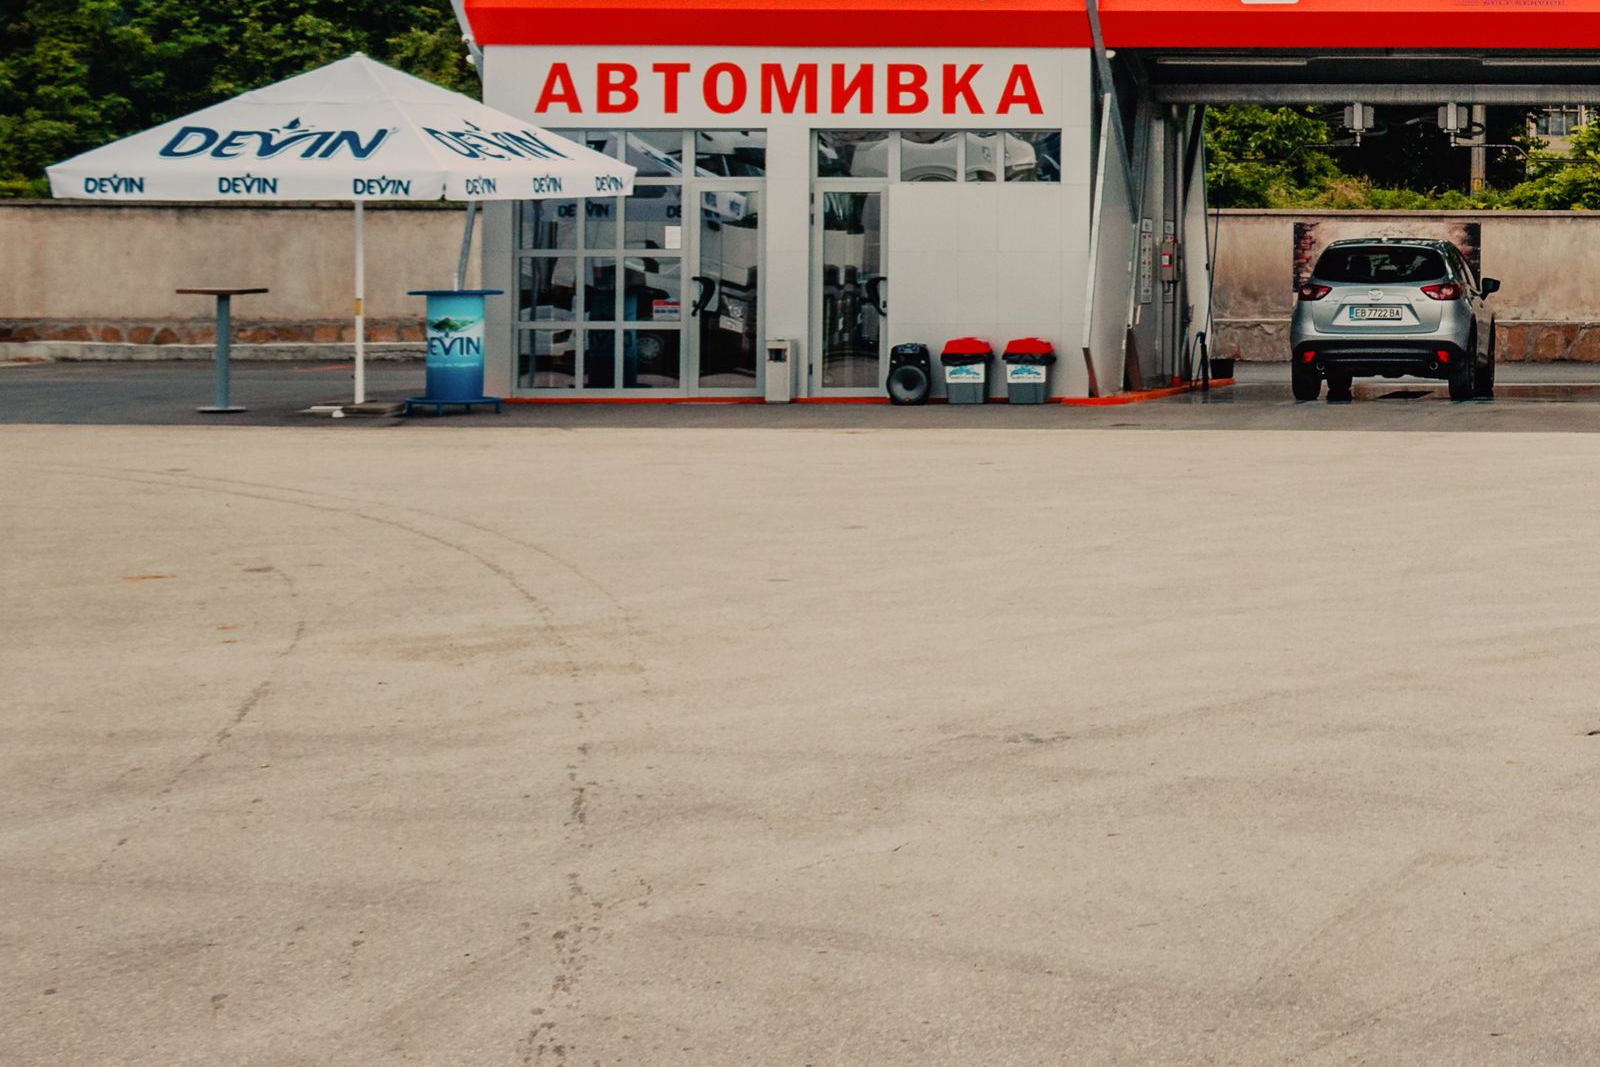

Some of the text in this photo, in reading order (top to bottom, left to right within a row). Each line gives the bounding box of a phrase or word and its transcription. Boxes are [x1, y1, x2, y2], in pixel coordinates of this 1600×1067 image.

[534, 62, 1044, 116] АВТОМИВКА
[159, 126, 389, 159] DEVIN
[421, 126, 569, 159] DEVIN
[84, 176, 145, 194] DEVIN
[218, 176, 278, 194] DEVIN
[353, 178, 411, 196] DEVIN
[428, 336, 480, 355] EVIN
